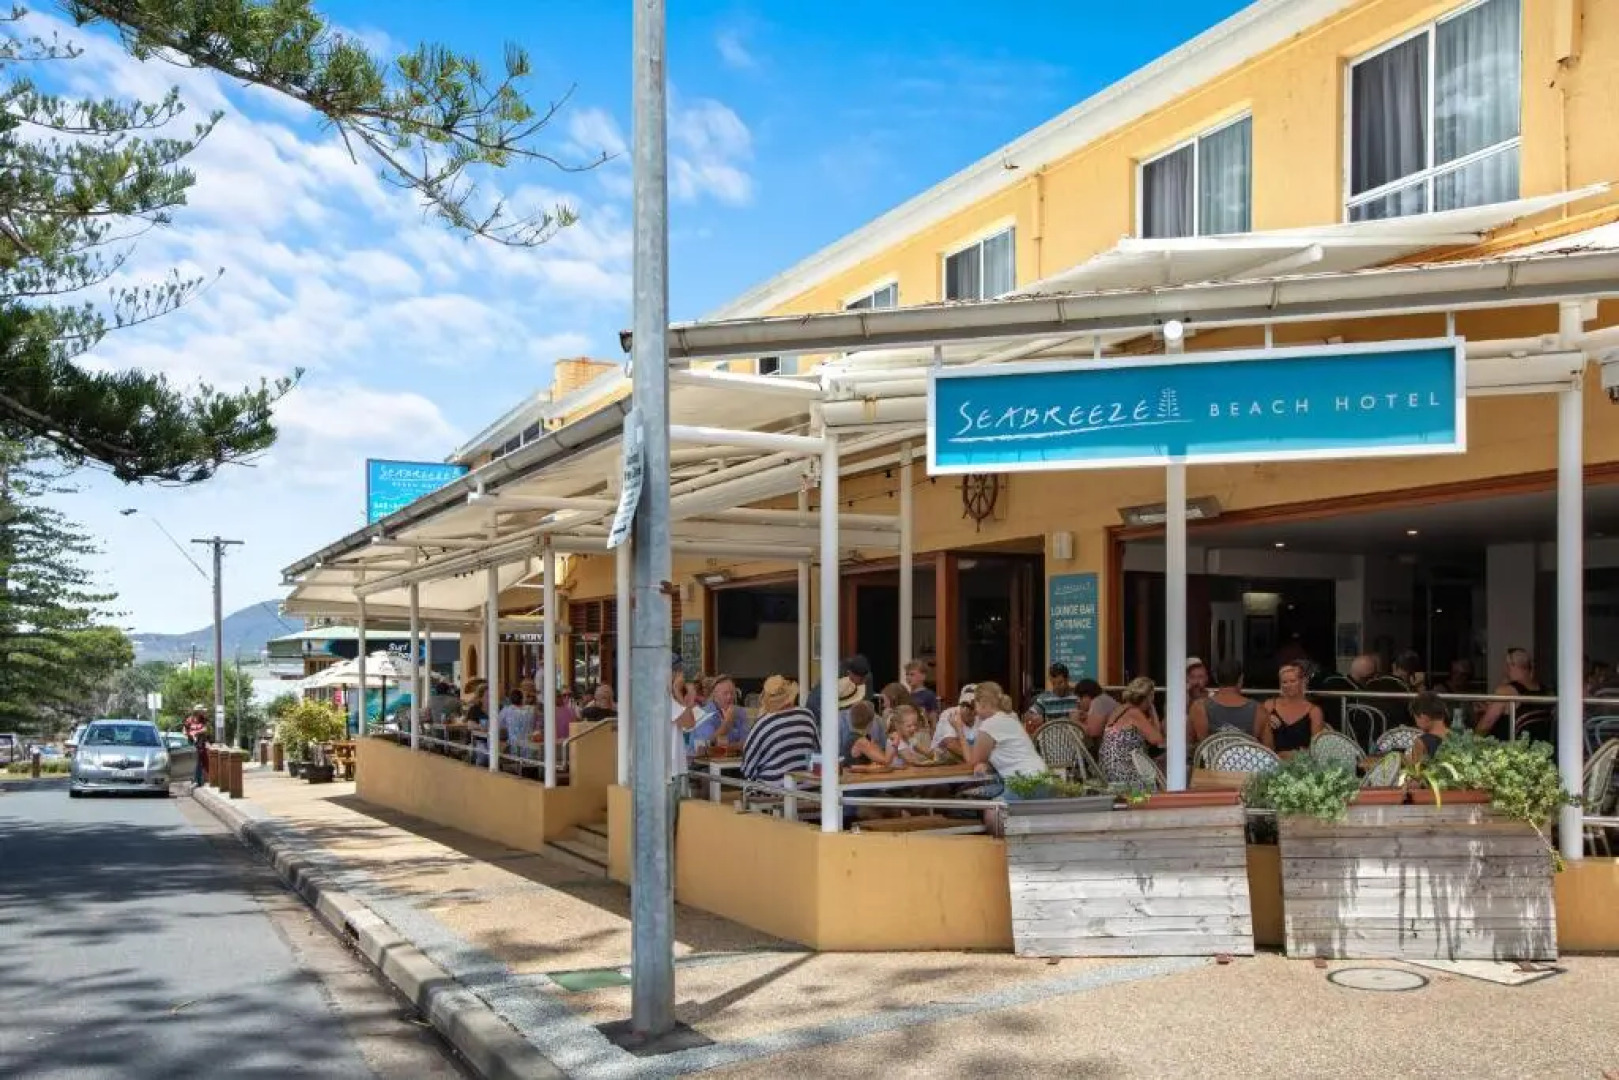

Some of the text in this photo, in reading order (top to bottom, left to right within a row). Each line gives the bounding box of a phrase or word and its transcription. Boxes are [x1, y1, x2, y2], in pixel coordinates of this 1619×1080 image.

[956, 392, 1440, 436] SEABREEZE BEACH HOTEL
[1051, 603, 1095, 616] LOUNGE BAR
[1055, 617, 1092, 629] ENTRANCE
[388, 641, 408, 652] Surf
